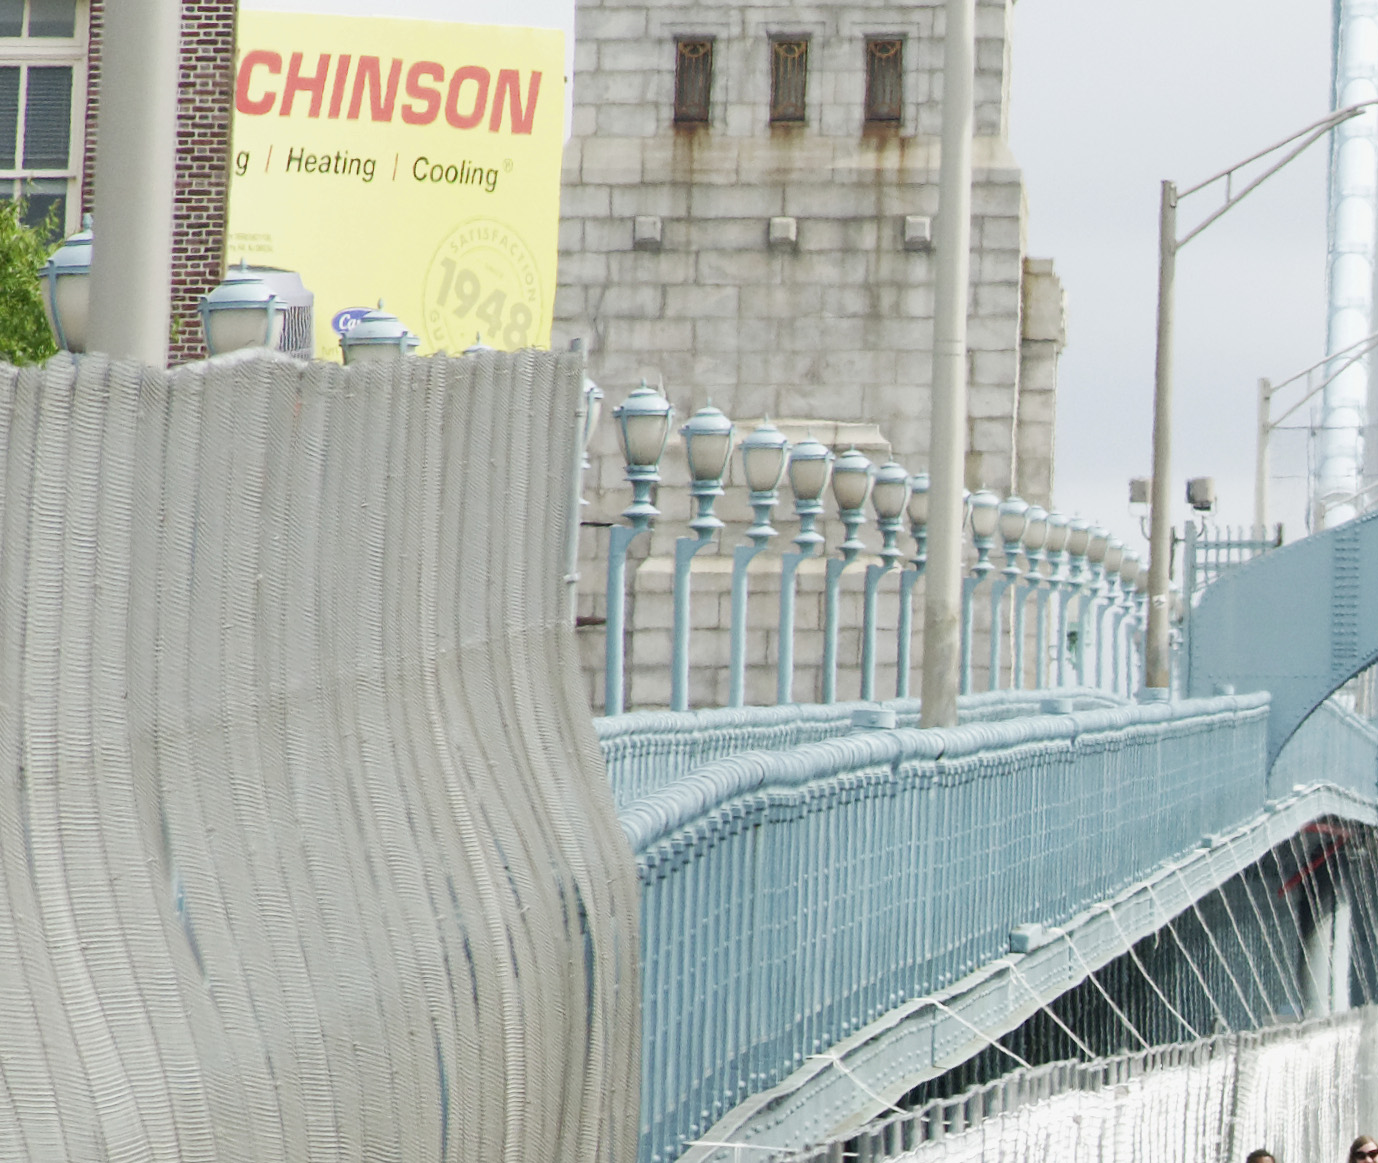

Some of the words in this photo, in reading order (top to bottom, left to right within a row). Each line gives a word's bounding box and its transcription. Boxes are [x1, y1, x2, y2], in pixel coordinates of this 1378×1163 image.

[236, 49, 543, 136] CHINSON
[286, 146, 377, 182] Heating
[436, 256, 533, 352] 1948
